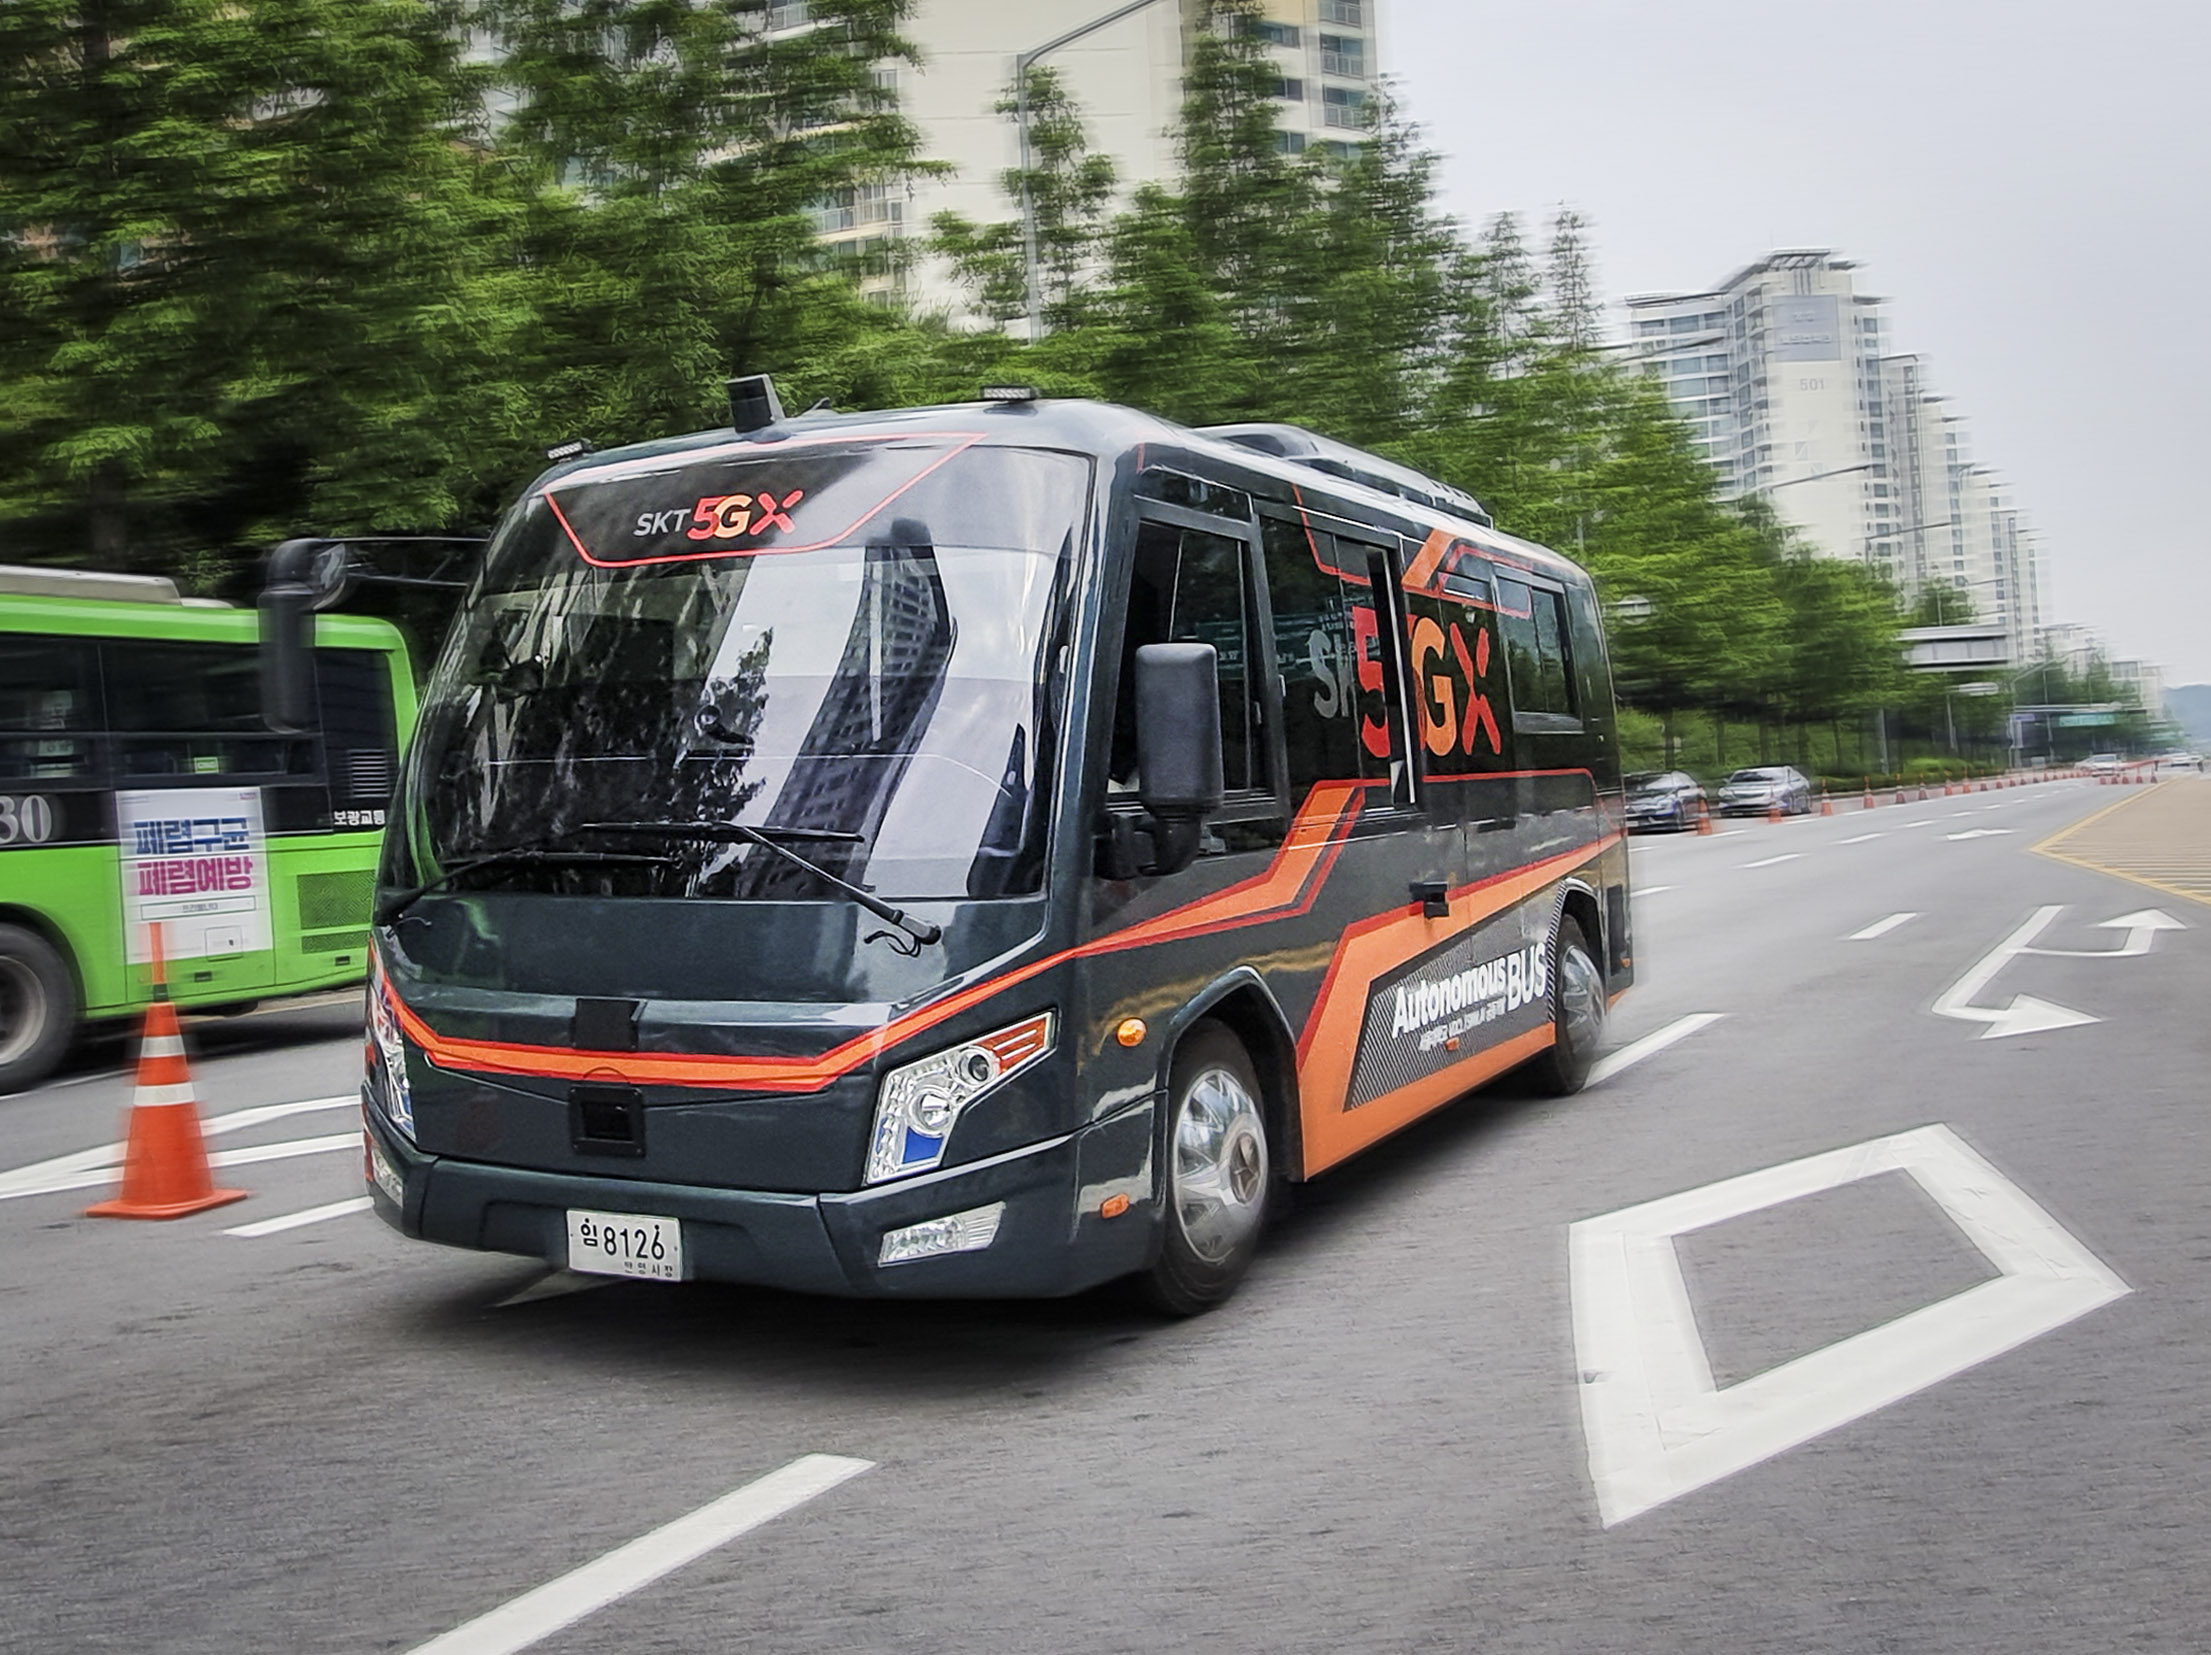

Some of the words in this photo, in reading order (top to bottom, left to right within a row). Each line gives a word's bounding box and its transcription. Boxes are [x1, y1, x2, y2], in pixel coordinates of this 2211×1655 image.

[1799, 377, 1825, 391] 501
[633, 508, 691, 536] SKT
[687, 490, 803, 540] 5GX
[134, 817, 249, 855] 폐렴구균
[137, 856, 253, 896] 폐렴예방
[1392, 957, 1507, 1039] Autonomous
[1507, 942, 1547, 1012] BUS
